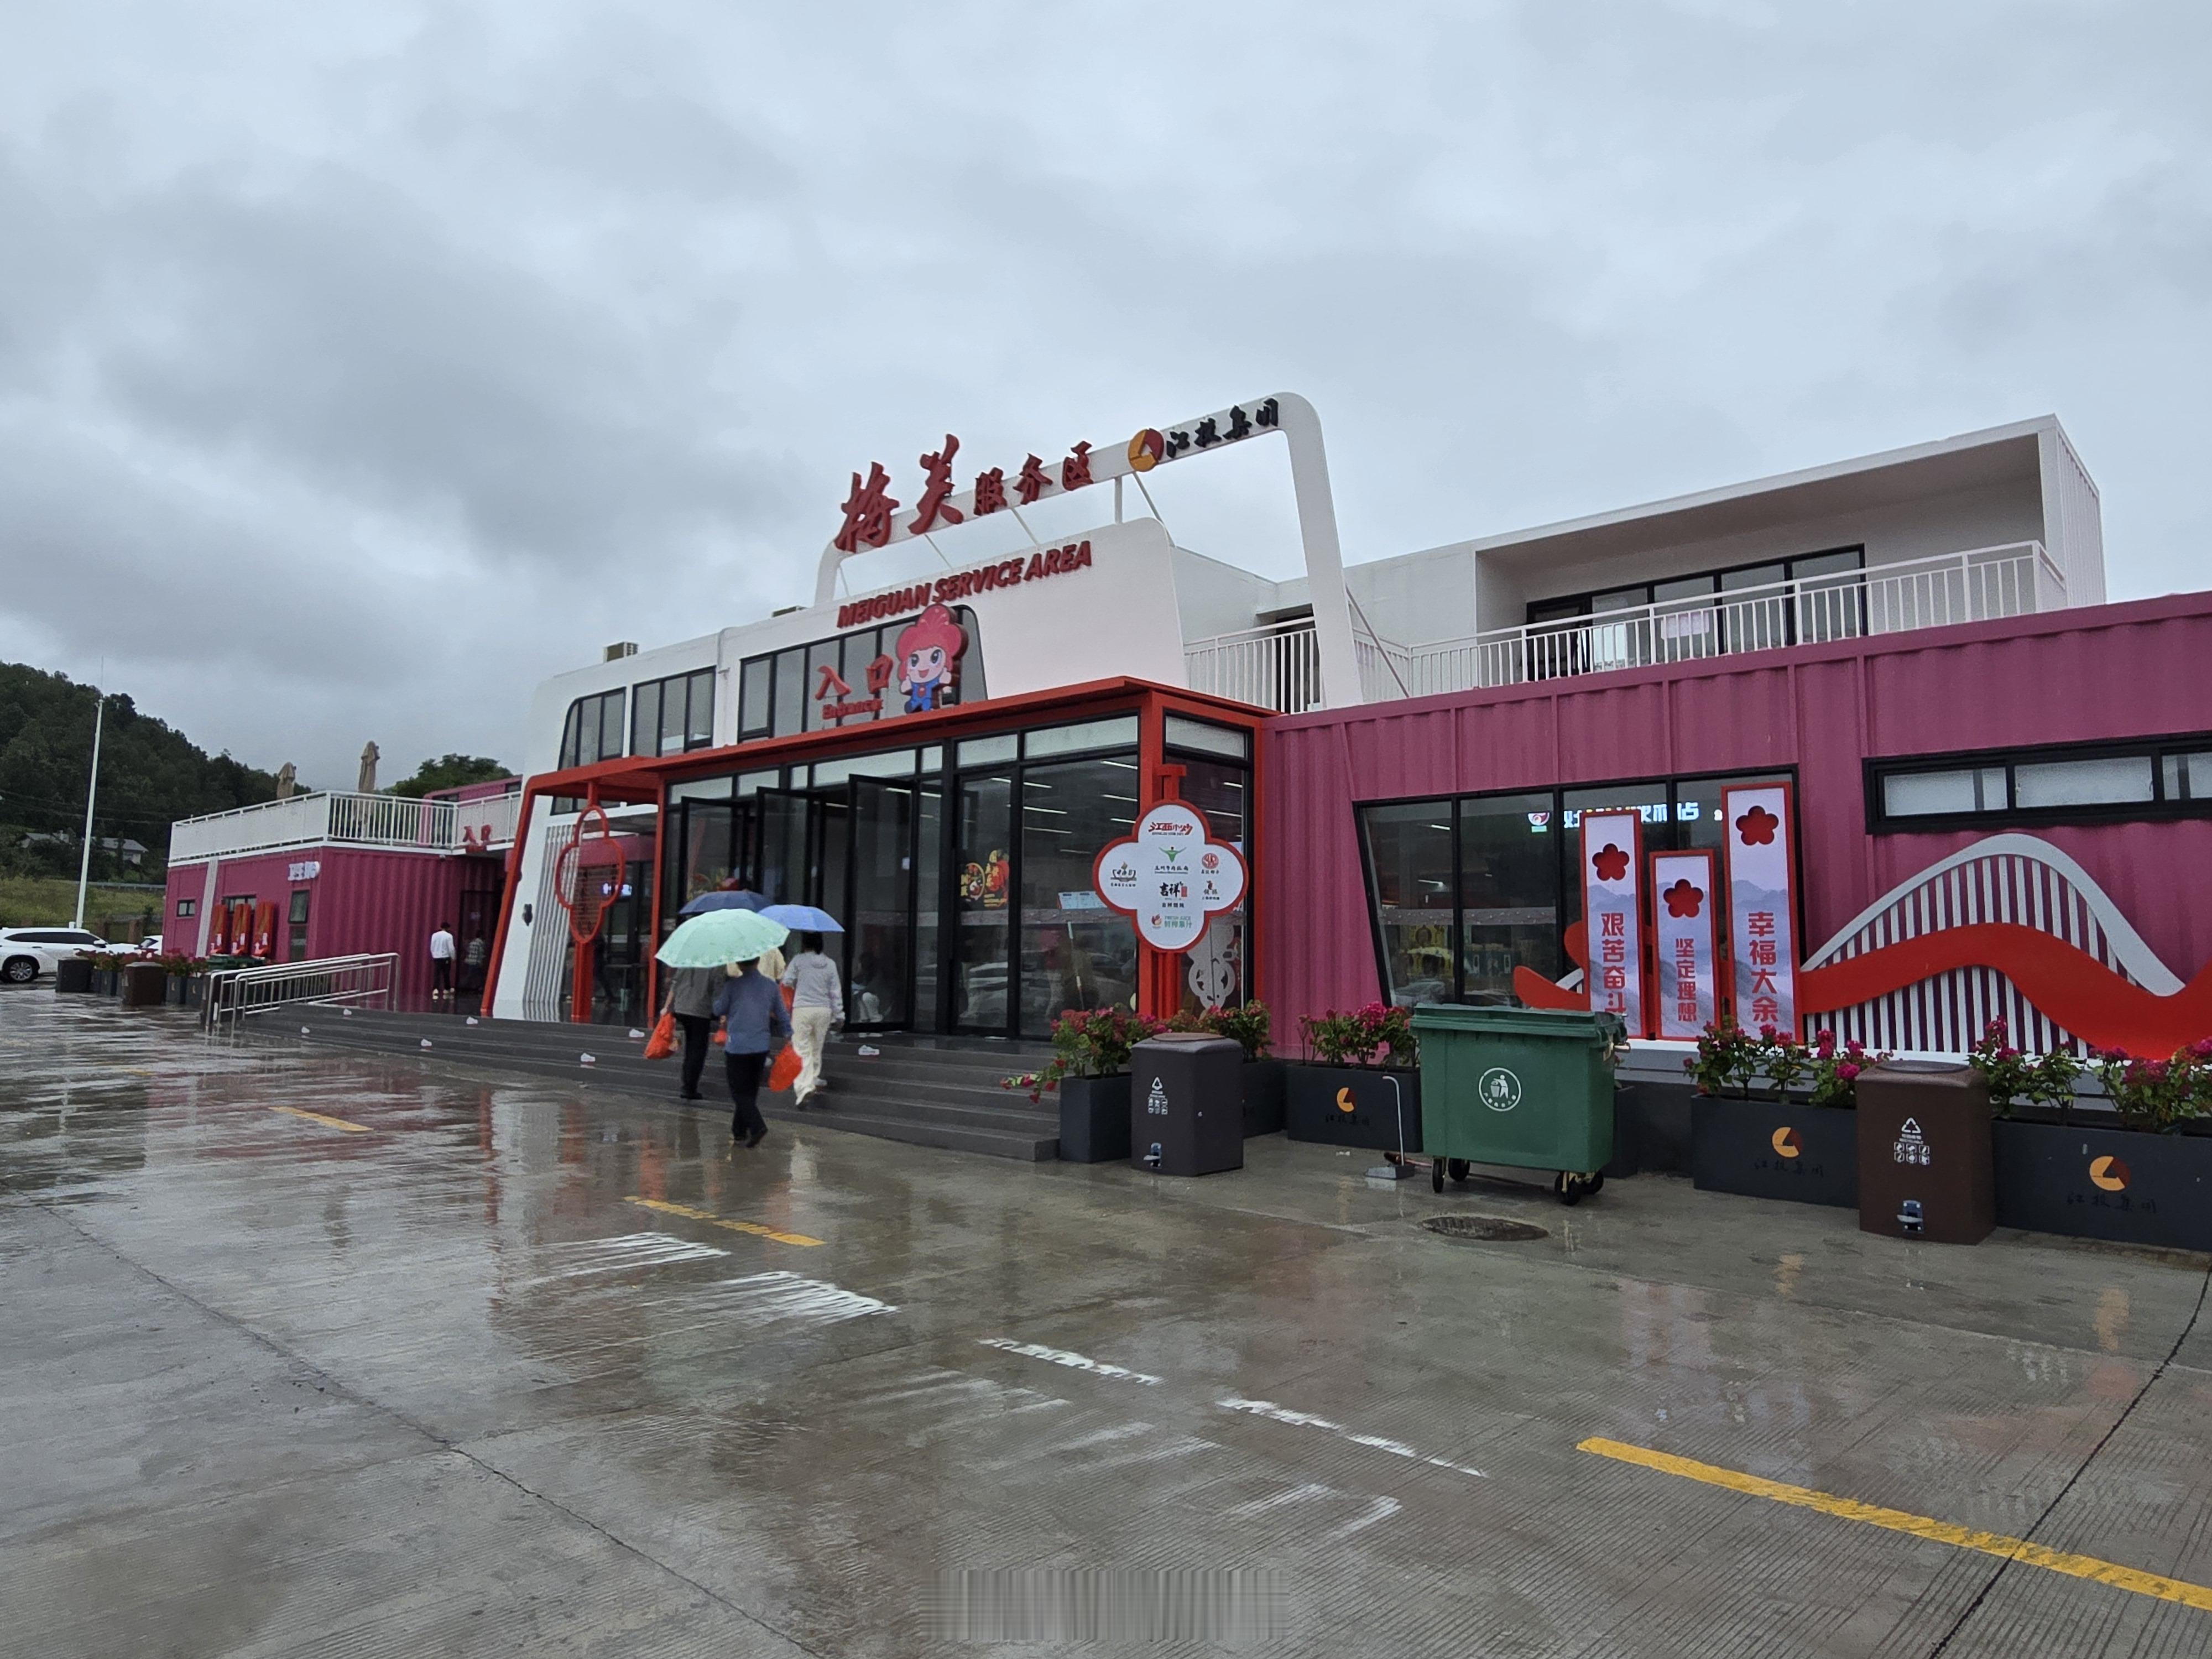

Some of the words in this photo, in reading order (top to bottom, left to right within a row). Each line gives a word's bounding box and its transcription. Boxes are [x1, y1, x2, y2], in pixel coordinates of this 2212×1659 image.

[837, 582, 932, 628] MEIGUAN
[932, 557, 1025, 603] SERVICE
[1024, 540, 1092, 581] AREA
[815, 654, 894, 700] 入口
[1601, 912, 1626, 1015] 艰苦奋斗
[1675, 938, 1697, 1022] 坚定理想
[1748, 911, 1778, 1022] 幸福大余
